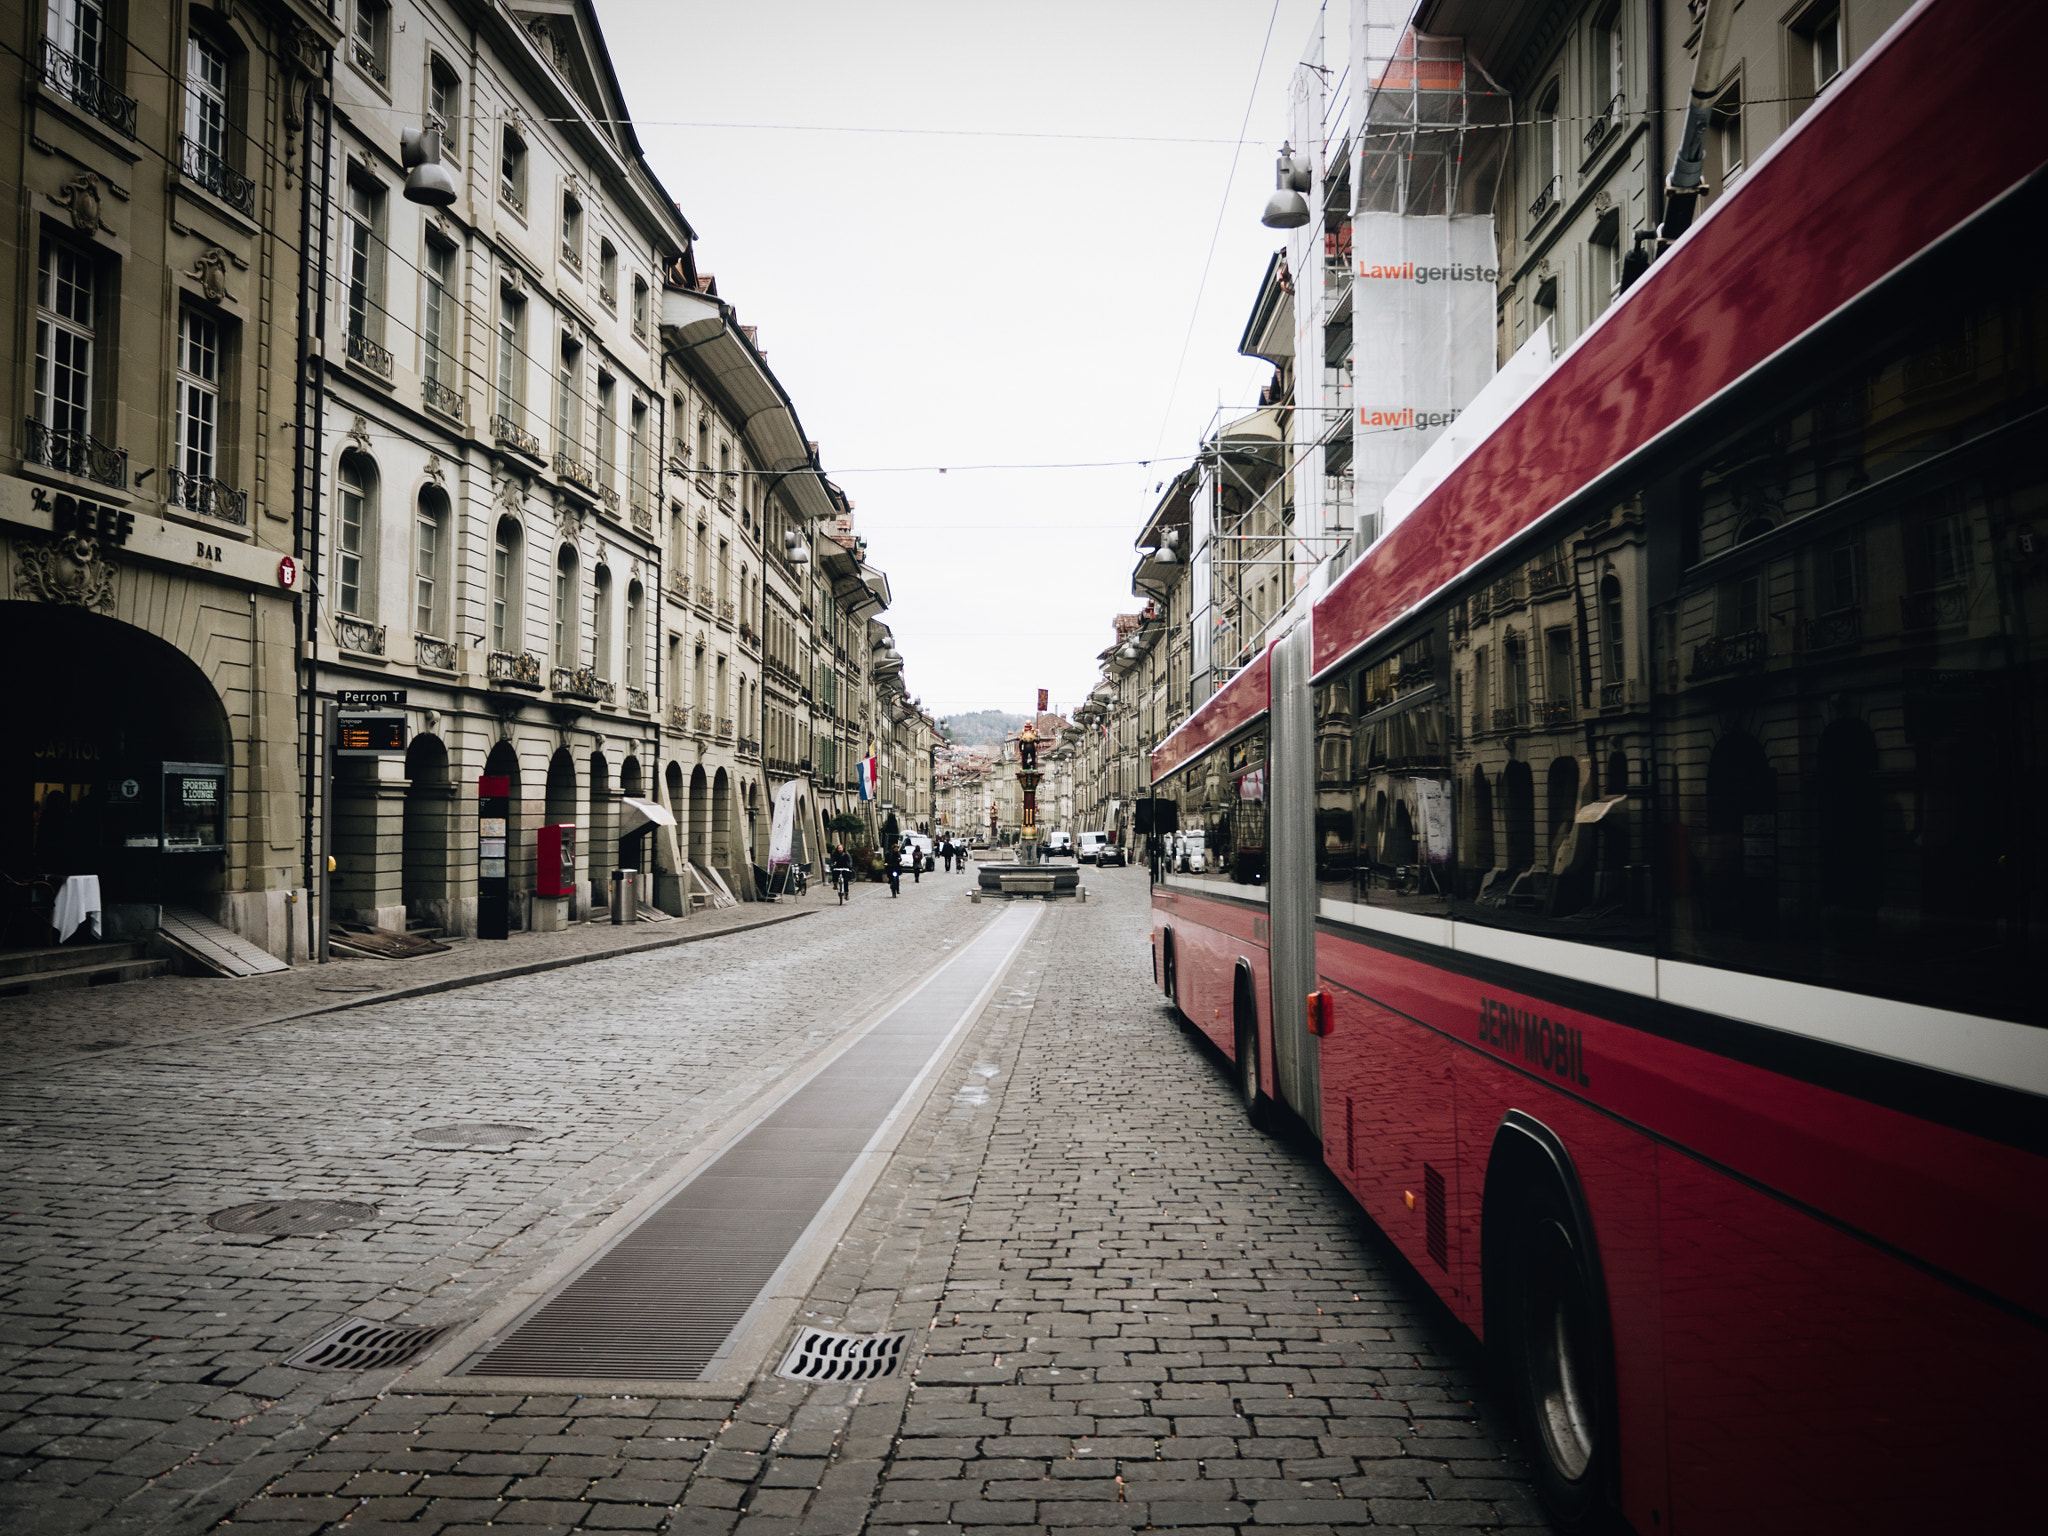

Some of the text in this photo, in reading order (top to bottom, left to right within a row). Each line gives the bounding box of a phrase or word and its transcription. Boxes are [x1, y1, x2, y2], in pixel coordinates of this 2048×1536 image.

[31, 487, 135, 546] The BEEF
[196, 541, 222, 563] BAR
[344, 691, 400, 702] Perron T
[182, 780, 217, 790] SPORTSBAR
[188, 790, 214, 799] LOUNGE
